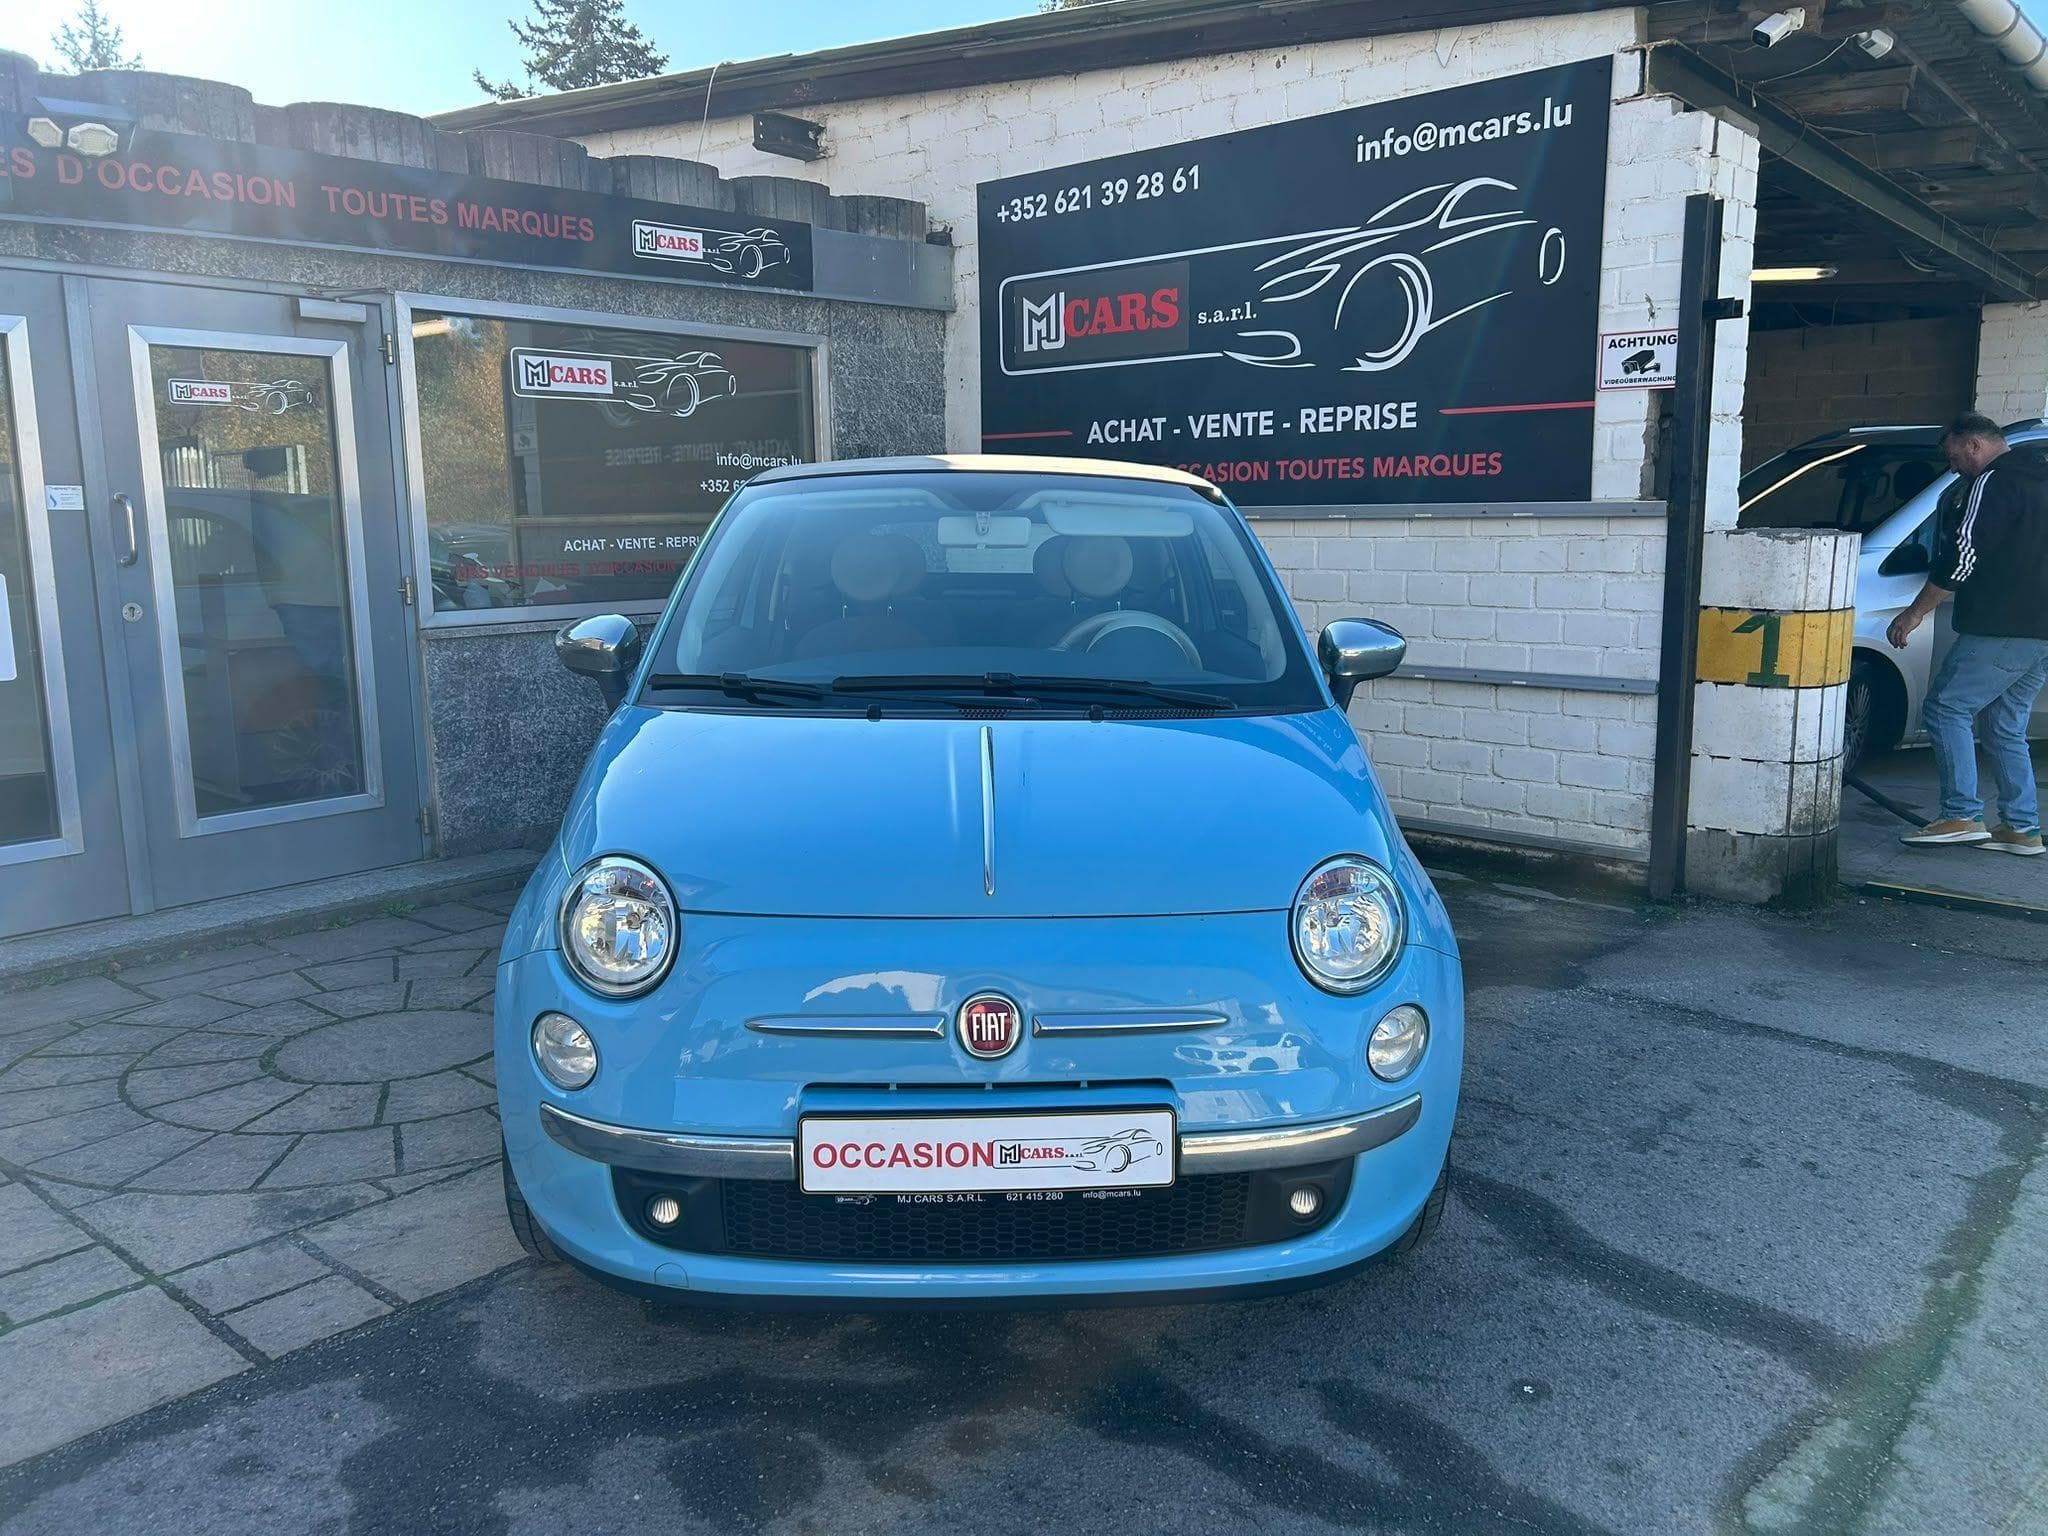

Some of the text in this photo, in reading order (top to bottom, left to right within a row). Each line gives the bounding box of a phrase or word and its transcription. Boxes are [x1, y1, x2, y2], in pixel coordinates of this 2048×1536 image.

[1356, 96, 1573, 163] info@mcars.lu
[57, 153, 297, 209] D'OCCASION
[321, 185, 449, 225] TOUTES
[457, 201, 595, 242] MARQUES
[997, 164, 1199, 223] +352 621 39 28 61
[1197, 301, 1258, 324] s.a.r.l.
[1608, 334, 1677, 349] ACHTUNG
[613, 380, 639, 388] s.a.r.l.
[1087, 416, 1166, 444] ACHAT
[1188, 410, 1274, 439] VENTE
[1300, 401, 1418, 434] REPRISE
[1276, 457, 1365, 480] TOUTES
[1373, 452, 1502, 478] MARQUES
[700, 479, 730, 492] +352
[564, 538, 606, 551] ACHAT
[616, 537, 657, 550] VENTE
[1731, 614, 1790, 688] 1
[972, 1012, 1008, 1041] FIAT
[813, 1142, 992, 1169] OCCASION
[897, 1189, 1141, 1204] MJ CARS S.A.R.L. 621 415 280 info@mcars.lu
